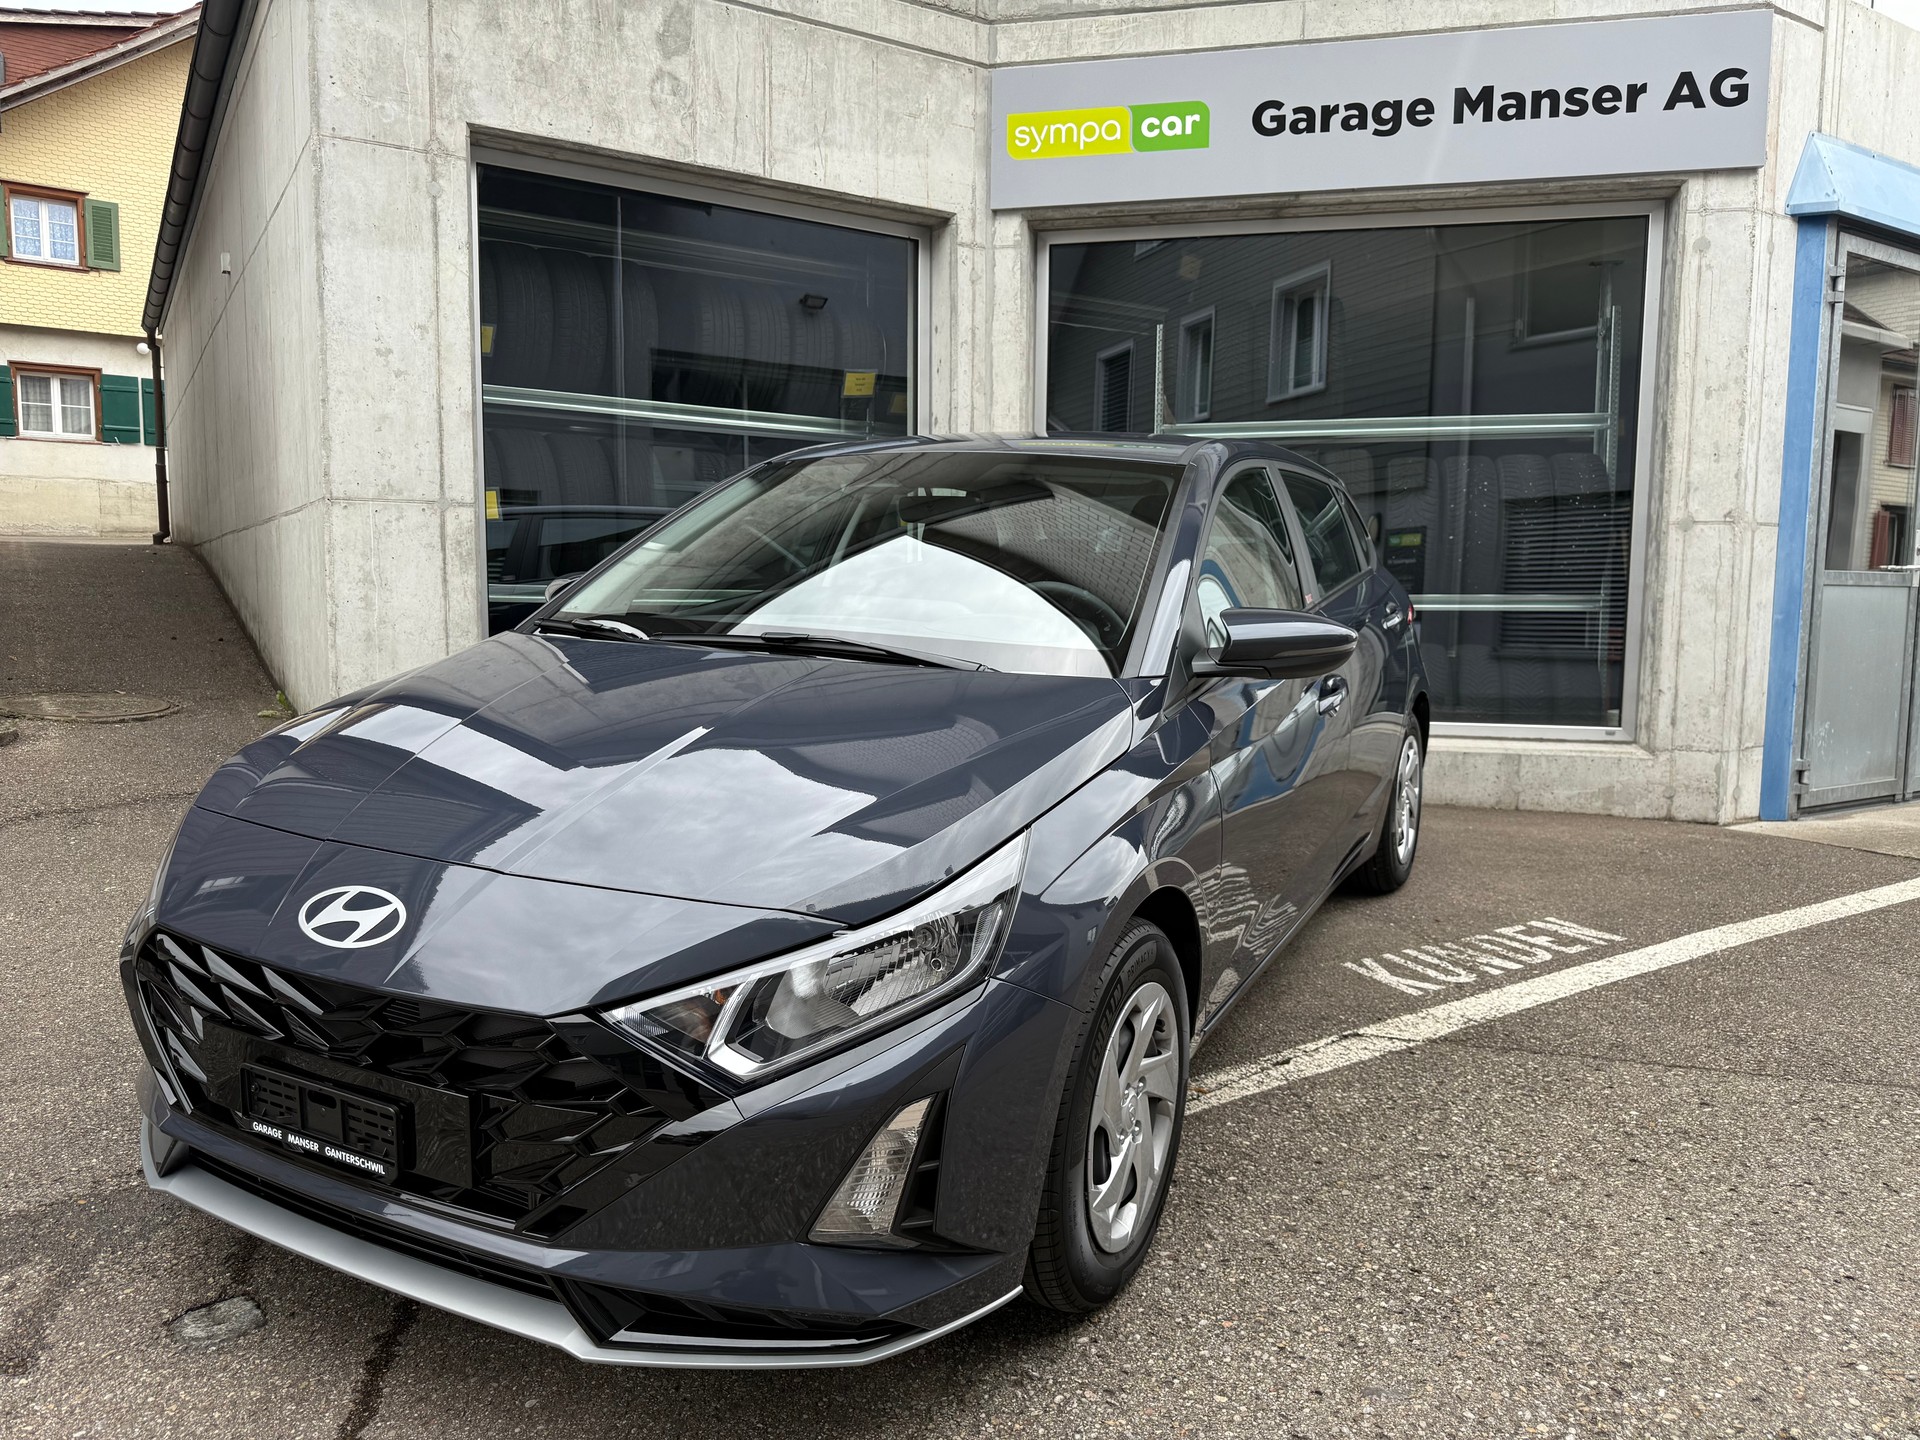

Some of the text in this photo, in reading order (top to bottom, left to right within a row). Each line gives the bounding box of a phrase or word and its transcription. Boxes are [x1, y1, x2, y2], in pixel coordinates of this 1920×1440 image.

[1014, 113, 1201, 153] sympa car
[1251, 67, 1750, 137] Garage Manser AG
[1340, 916, 1628, 996] KUNDEN
[252, 1121, 386, 1175] GARAGE MANSER GANTERSCHWIL
